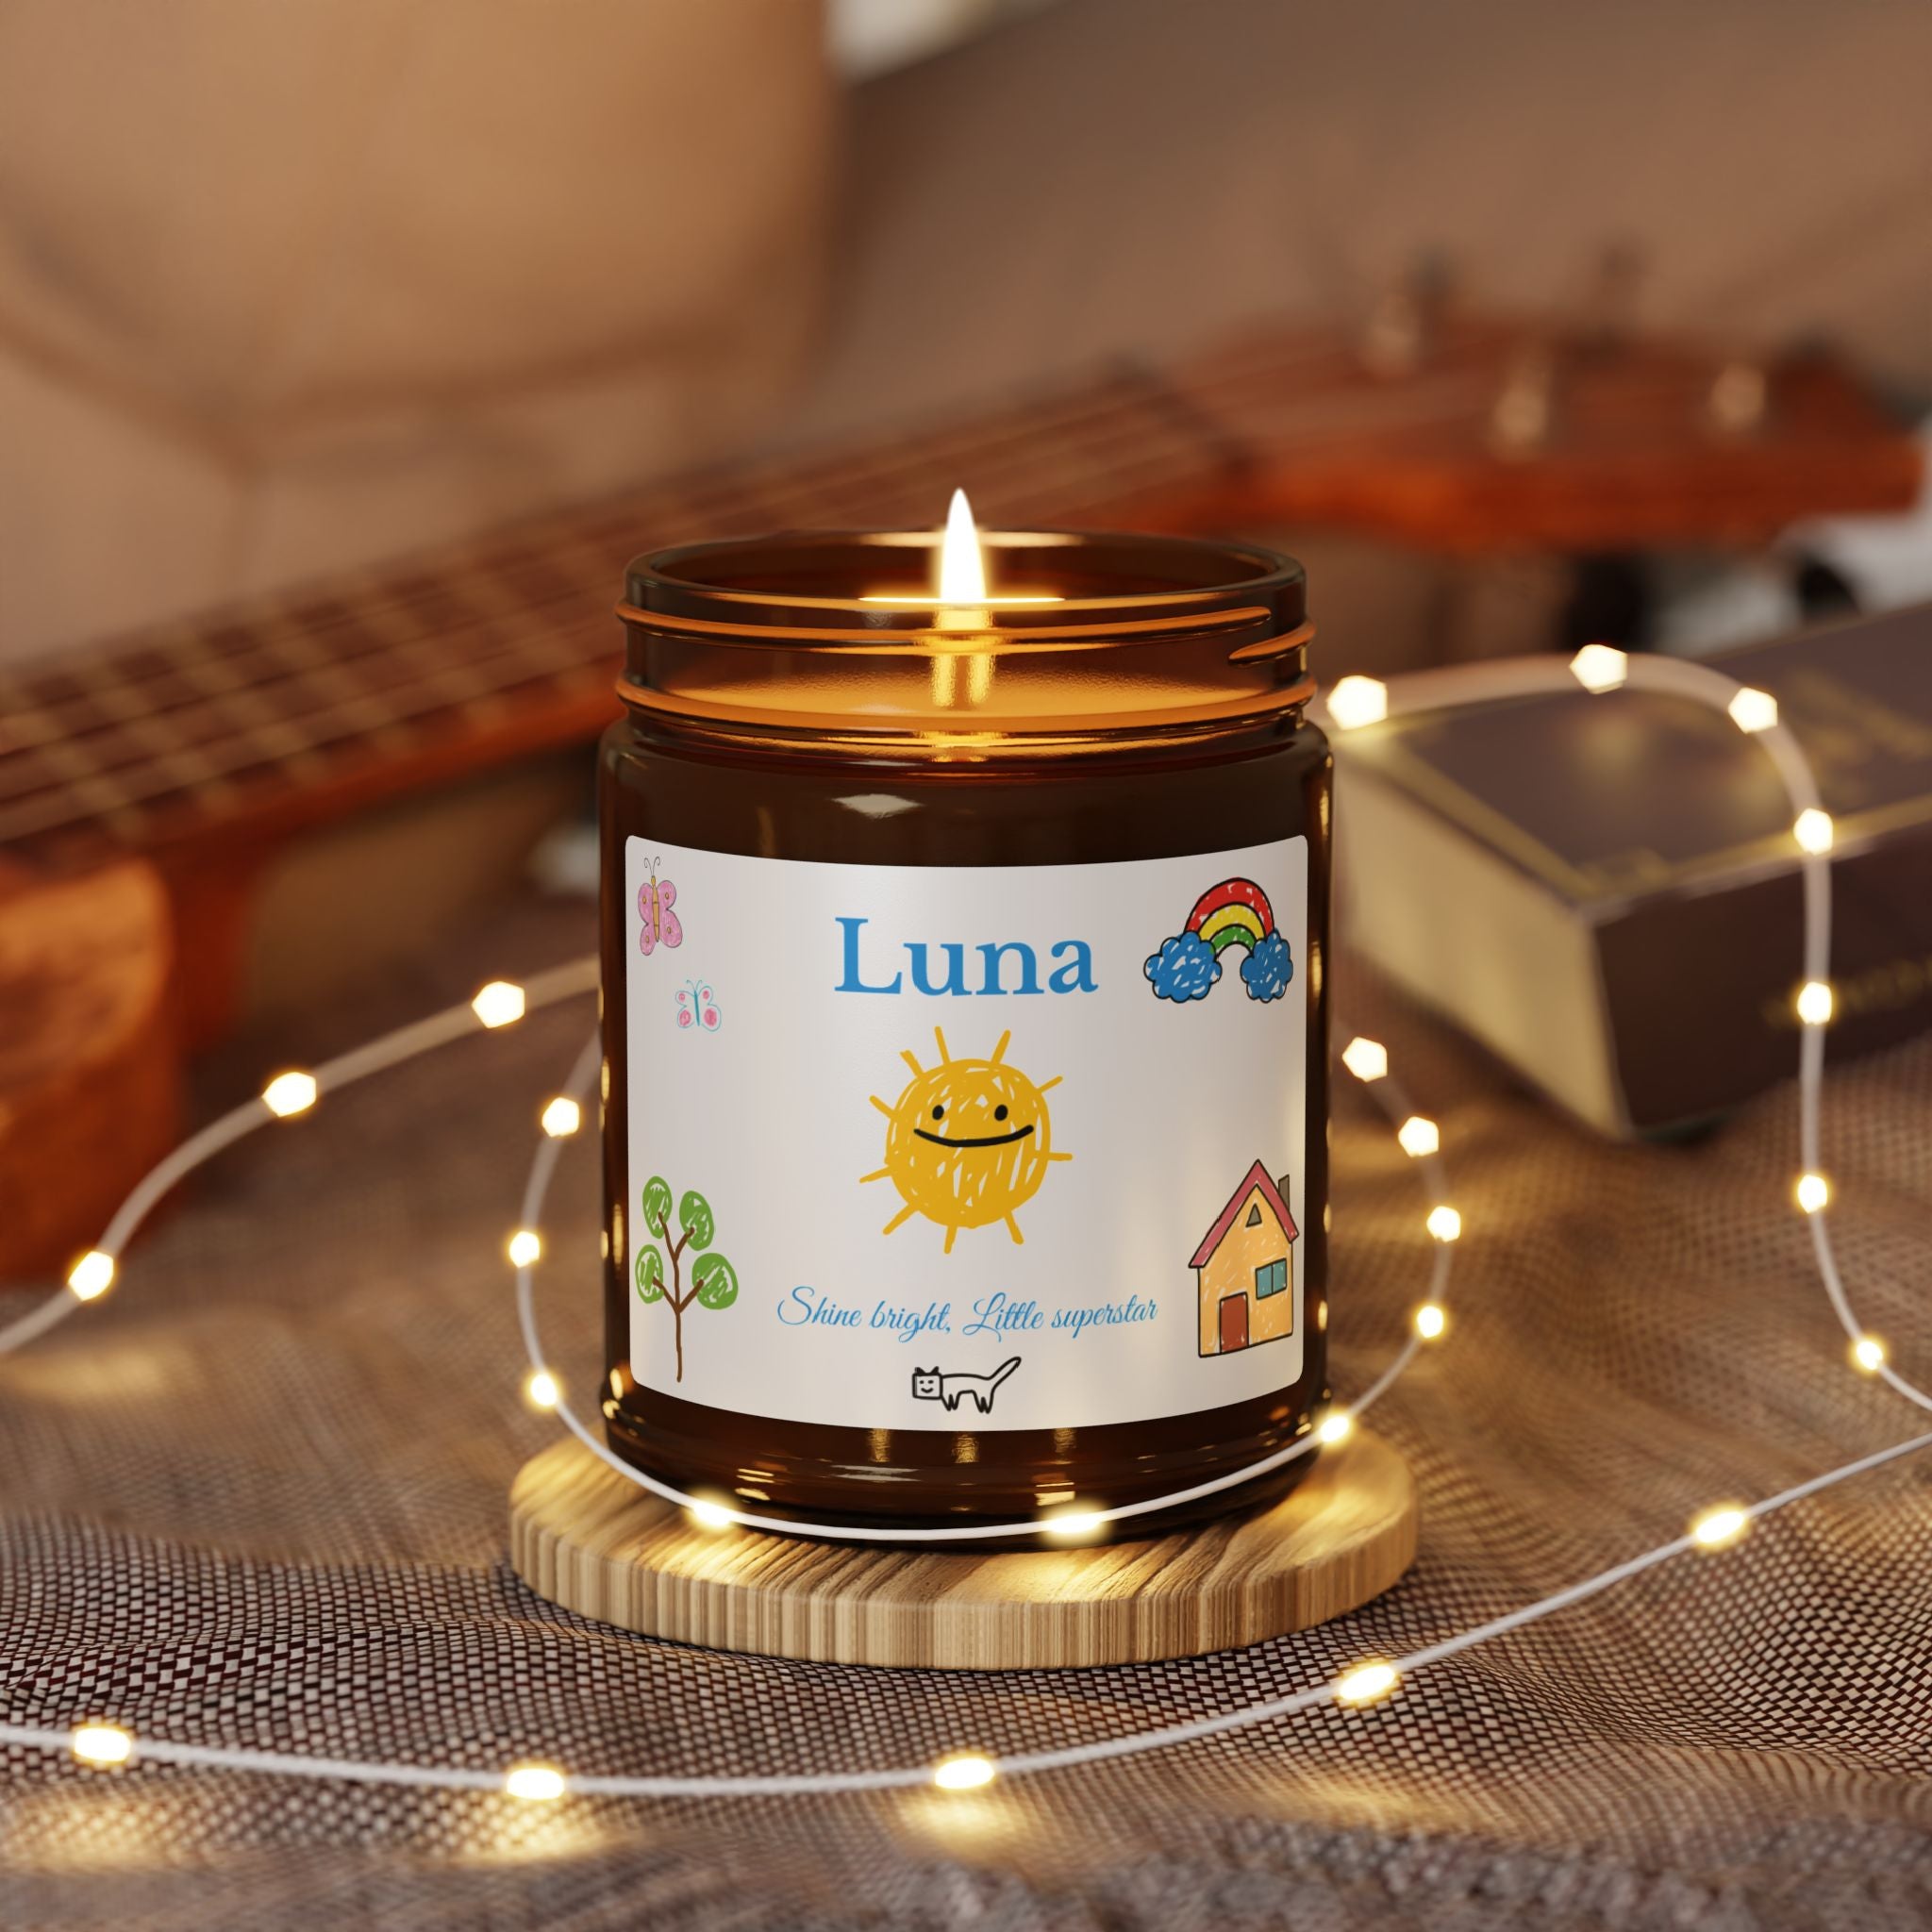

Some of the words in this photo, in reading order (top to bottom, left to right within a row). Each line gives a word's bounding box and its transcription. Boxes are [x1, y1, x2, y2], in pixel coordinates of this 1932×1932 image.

[834, 916, 1099, 997] Luna
[776, 1286, 862, 1327] Shine
[869, 1300, 952, 1343] bright,
[962, 1291, 1043, 1343] Little
[1050, 1294, 1159, 1339] superstar
